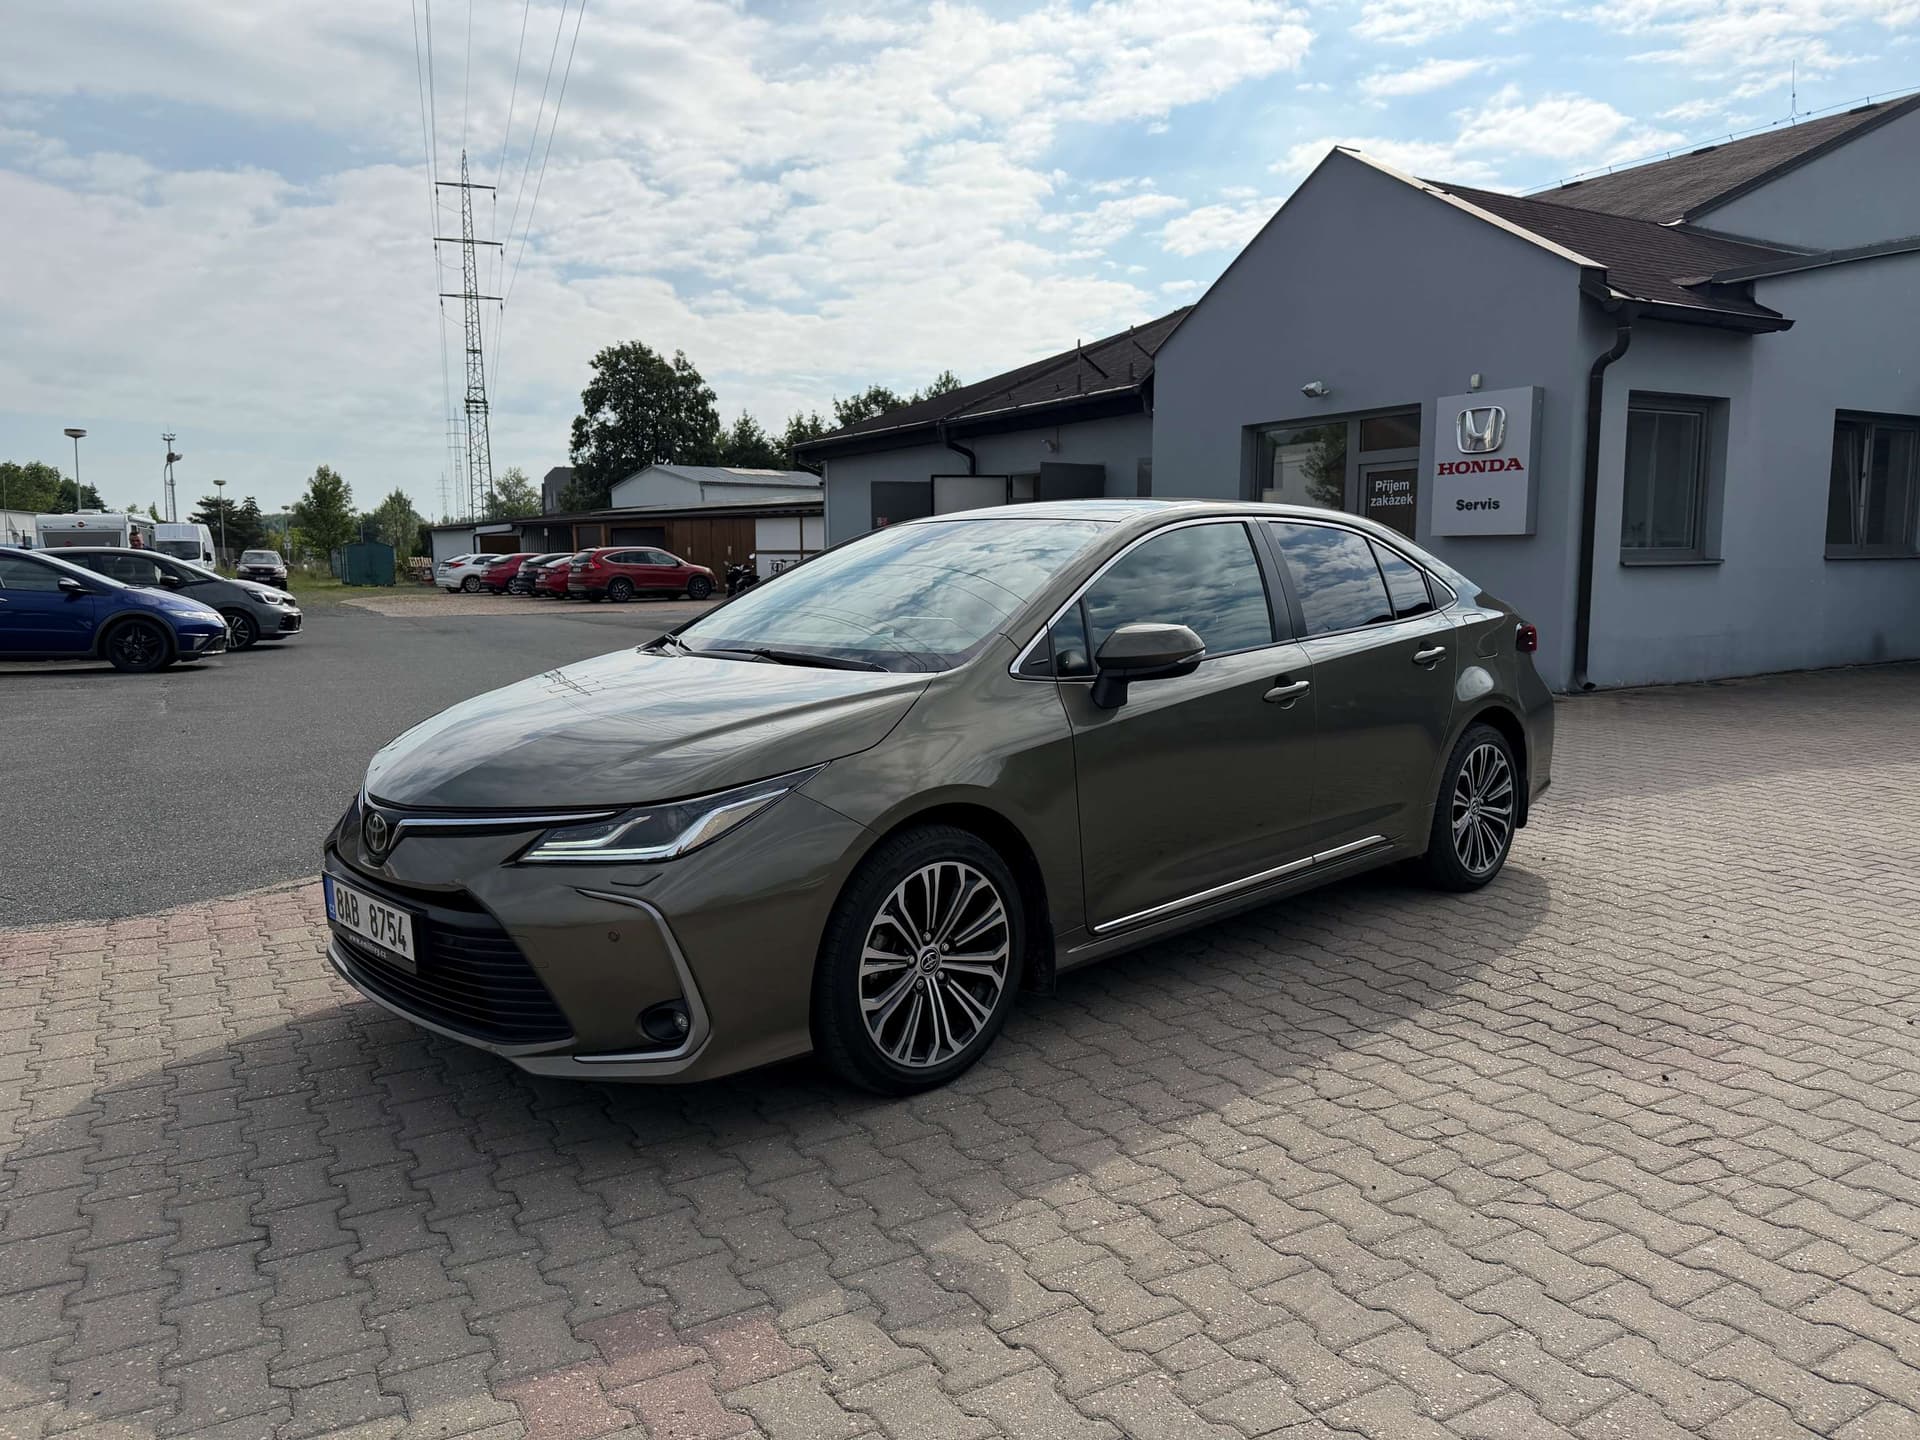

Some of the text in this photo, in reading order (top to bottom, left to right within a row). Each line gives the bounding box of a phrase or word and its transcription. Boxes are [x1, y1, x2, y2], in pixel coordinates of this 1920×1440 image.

[1437, 458, 1524, 475] HONDA
[1370, 493, 1414, 507] zakázek
[1455, 498, 1501, 511] Servis
[336, 887, 360, 928] 8AB
[369, 903, 406, 952] 8754
